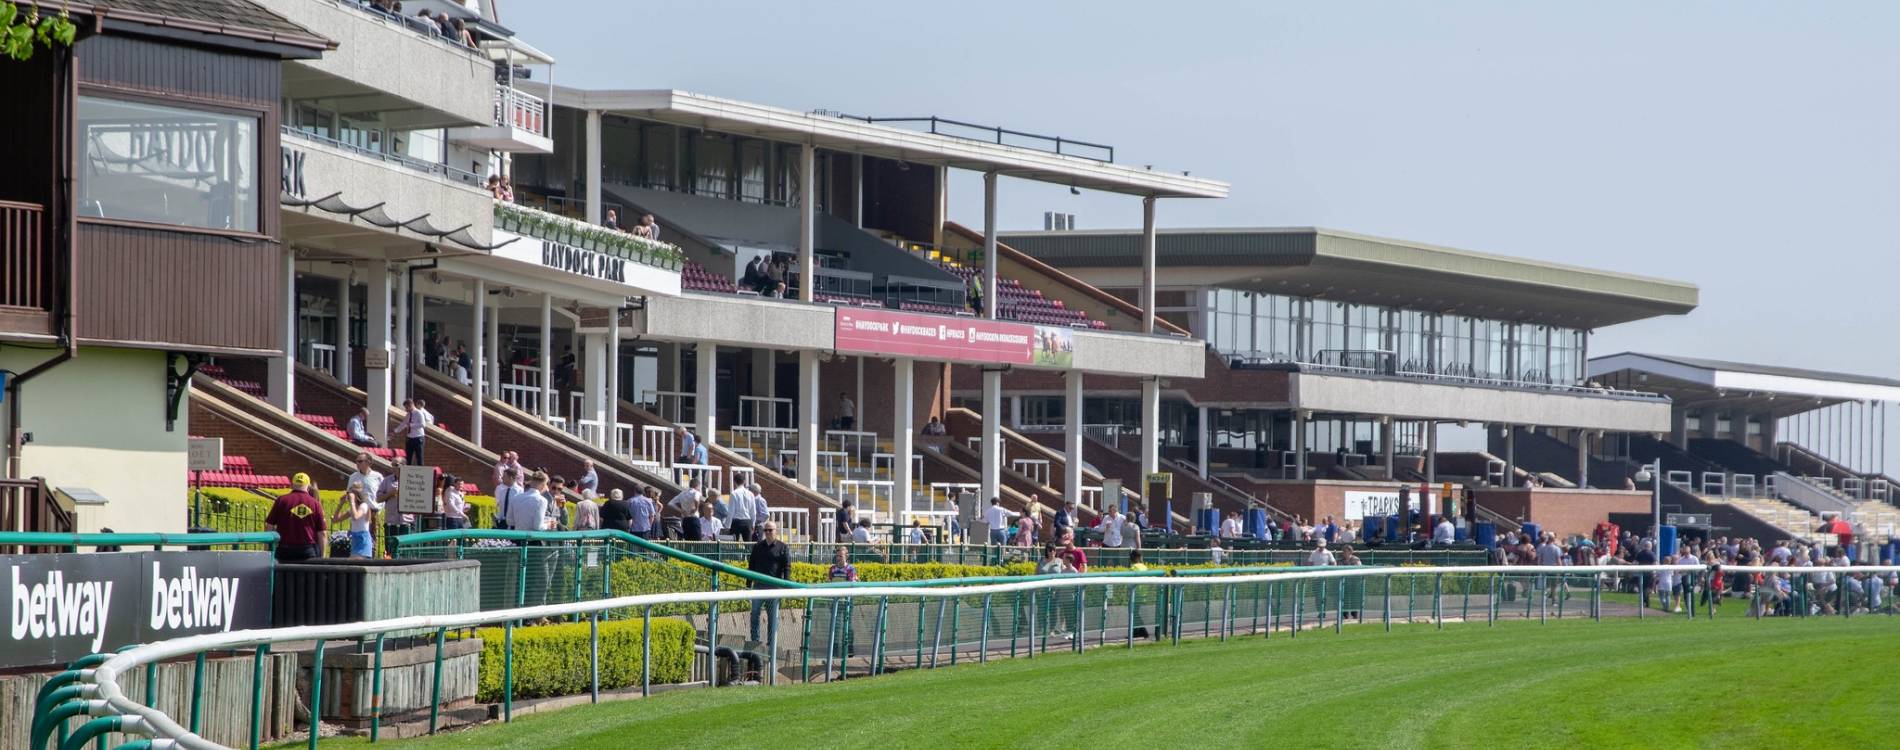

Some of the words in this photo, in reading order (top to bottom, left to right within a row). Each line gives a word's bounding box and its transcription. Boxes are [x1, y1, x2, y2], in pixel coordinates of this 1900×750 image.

[281, 146, 306, 198] RK
[542, 241, 595, 277] HAYDOCK
[598, 254, 625, 283] PARK
[1368, 496, 1400, 516] TRACKS
[11, 565, 113, 654] betway
[150, 560, 240, 633] betway
